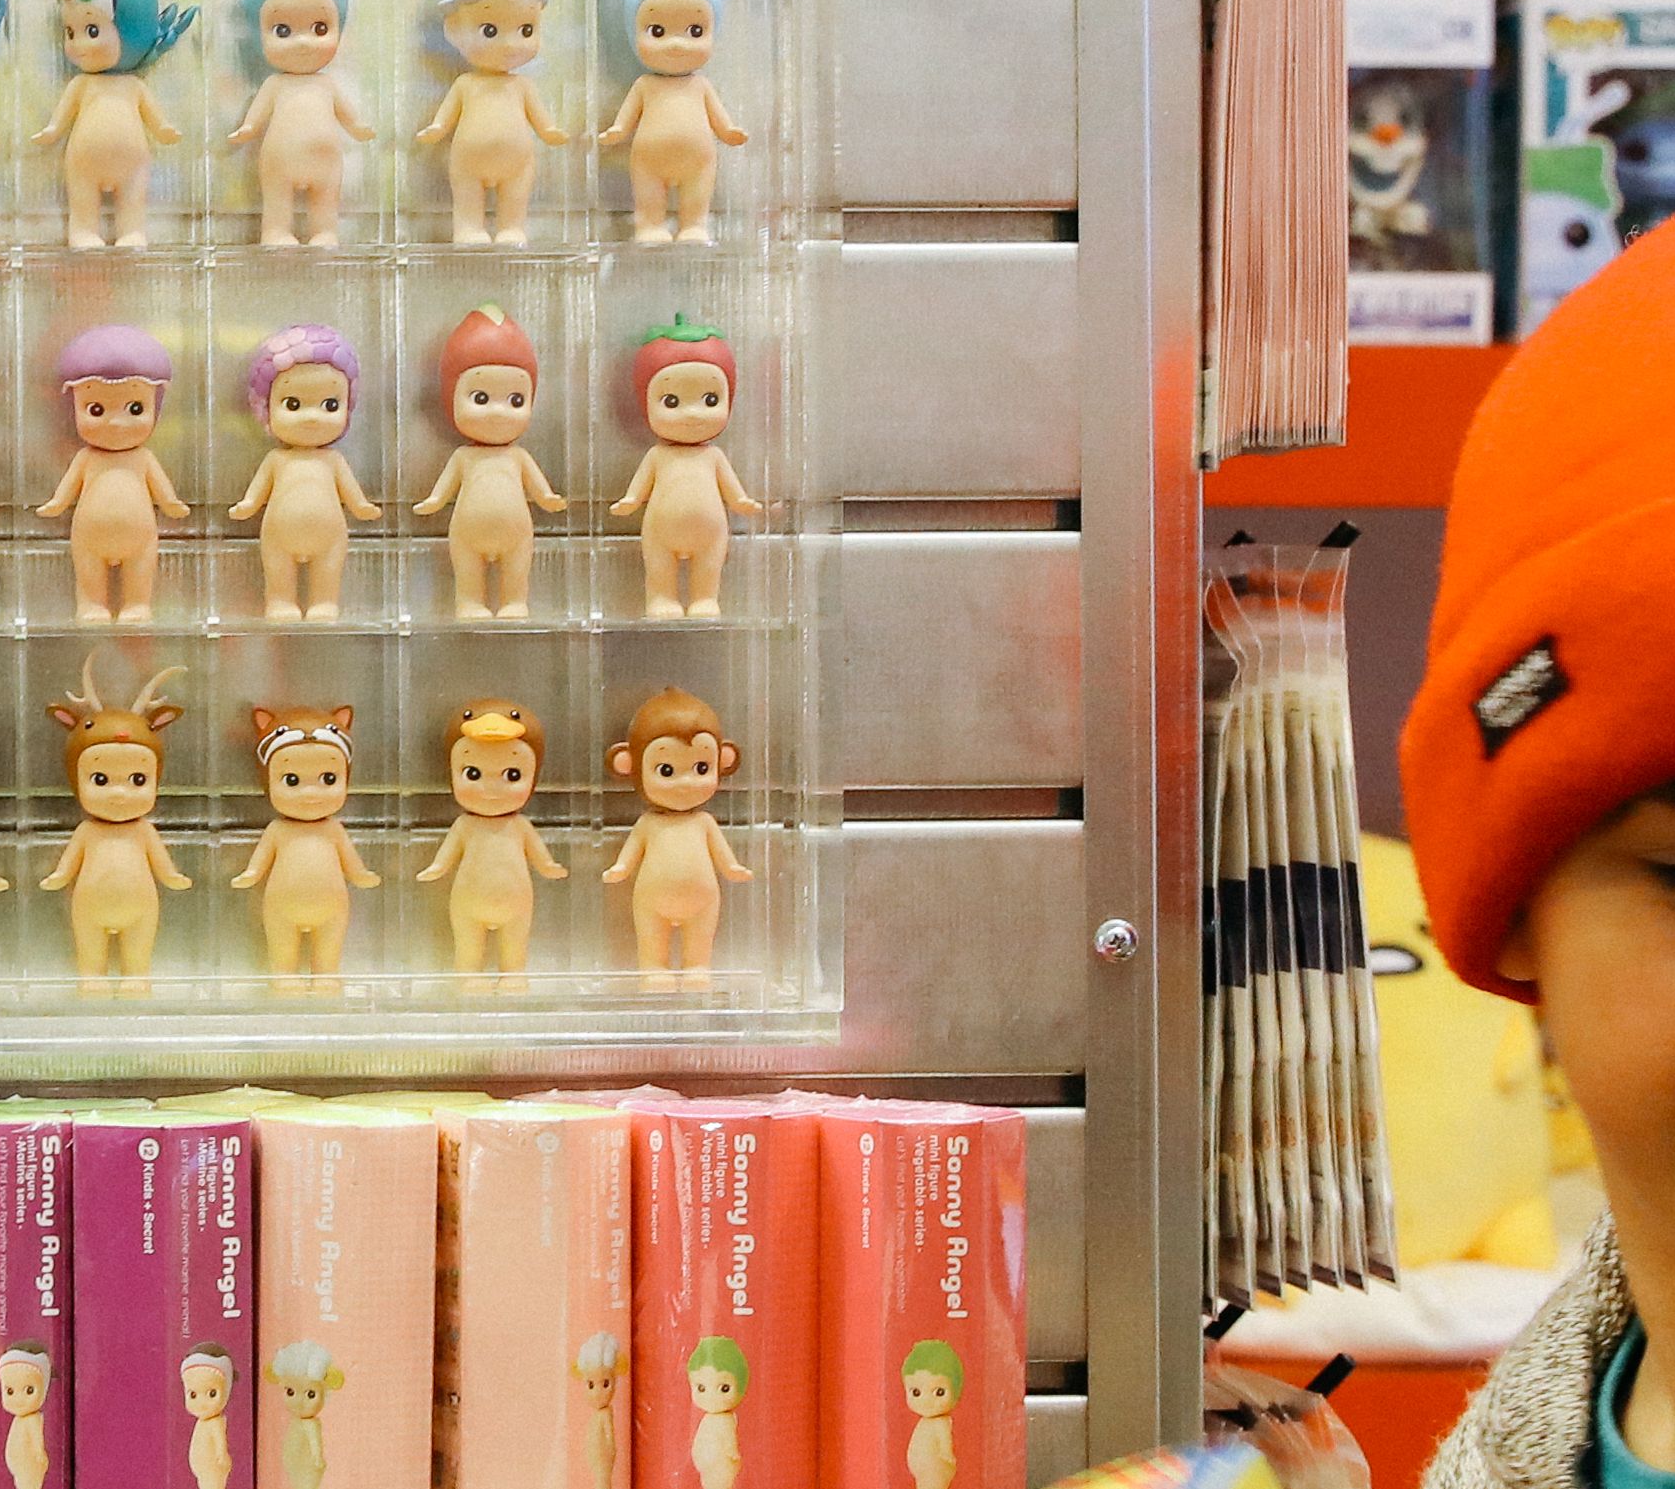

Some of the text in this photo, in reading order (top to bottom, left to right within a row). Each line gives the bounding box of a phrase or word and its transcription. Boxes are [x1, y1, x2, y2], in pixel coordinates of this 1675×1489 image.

[24, 1135, 39, 1201] mini figure
[142, 1162, 155, 1201] Kinds
[204, 1136, 219, 1203] mini figure
[651, 1153, 660, 1190] Kinds
[713, 1132, 728, 1198] mini figure
[861, 1157, 872, 1194] Kinds
[927, 1134, 942, 1201] mini figure
[35, 1135, 61, 1317] Sonny Angel
[142, 1212, 156, 1255] Secret
[217, 1136, 242, 1319] Sonny Angel
[313, 1140, 343, 1322] Sonny Angel
[606, 1128, 627, 1310] Sonny Angel
[725, 1133, 757, 1316] Sonny Angel
[861, 1207, 872, 1249] Secret
[940, 1135, 970, 1320] Sonny Angel
